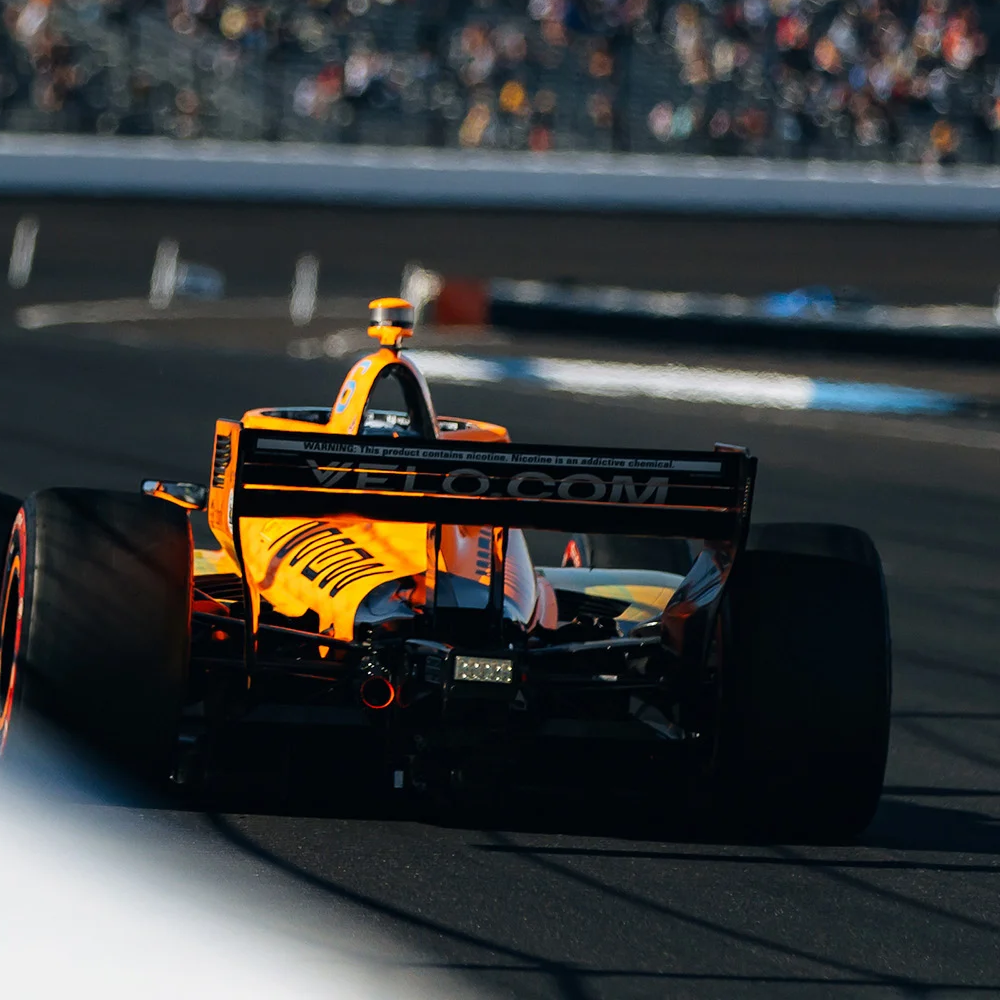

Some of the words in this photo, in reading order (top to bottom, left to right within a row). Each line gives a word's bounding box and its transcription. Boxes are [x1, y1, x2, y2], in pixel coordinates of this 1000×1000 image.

[303, 442, 357, 454] WARNING:
[360, 445, 380, 455] This
[382, 446, 420, 458] product
[422, 449, 464, 461] contains
[466, 451, 508, 463] nicotine.
[511, 453, 552, 465] Nicotine
[555, 455, 564, 465] is
[566, 456, 578, 466] an
[581, 456, 625, 468] addictive
[628, 459, 675, 470] chemical.
[306, 459, 670, 504] VELO.COM
